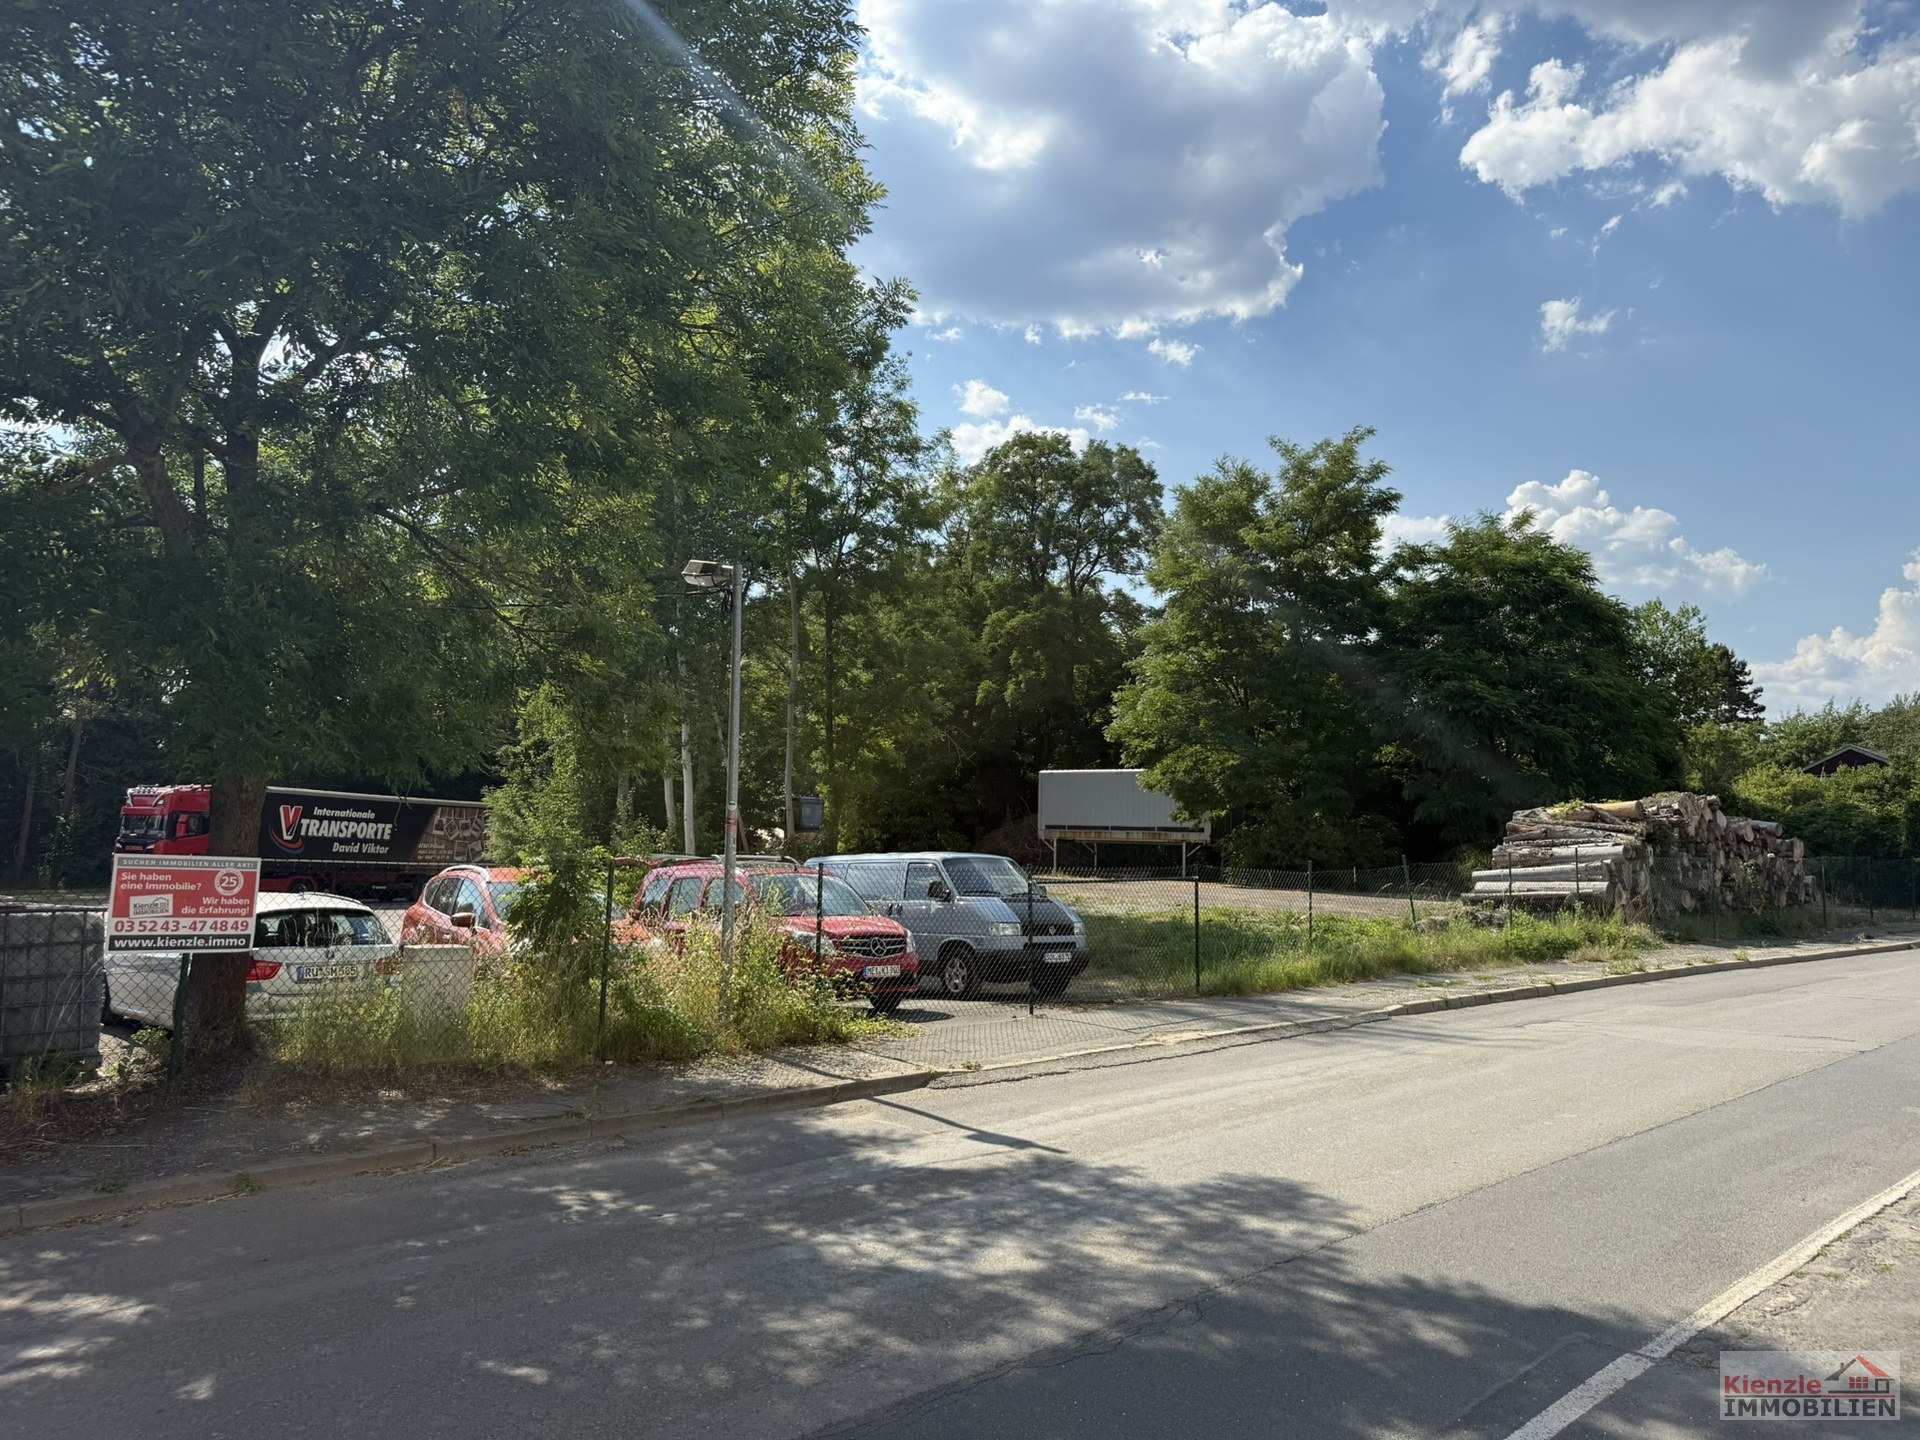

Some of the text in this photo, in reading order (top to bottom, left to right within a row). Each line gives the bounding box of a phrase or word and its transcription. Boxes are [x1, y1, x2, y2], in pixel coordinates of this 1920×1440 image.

[313, 806, 376, 819] Internationale
[300, 818, 393, 840] TRANSPORTE
[332, 842, 390, 854] David Viktor
[121, 872, 172, 881] Sie haben
[221, 876, 238, 887] 25
[120, 882, 202, 891] eine Immobilie?
[202, 896, 250, 905] Wir haben
[181, 906, 250, 916] die Erfahrung!
[114, 936, 247, 948] www.kienzle.immo
